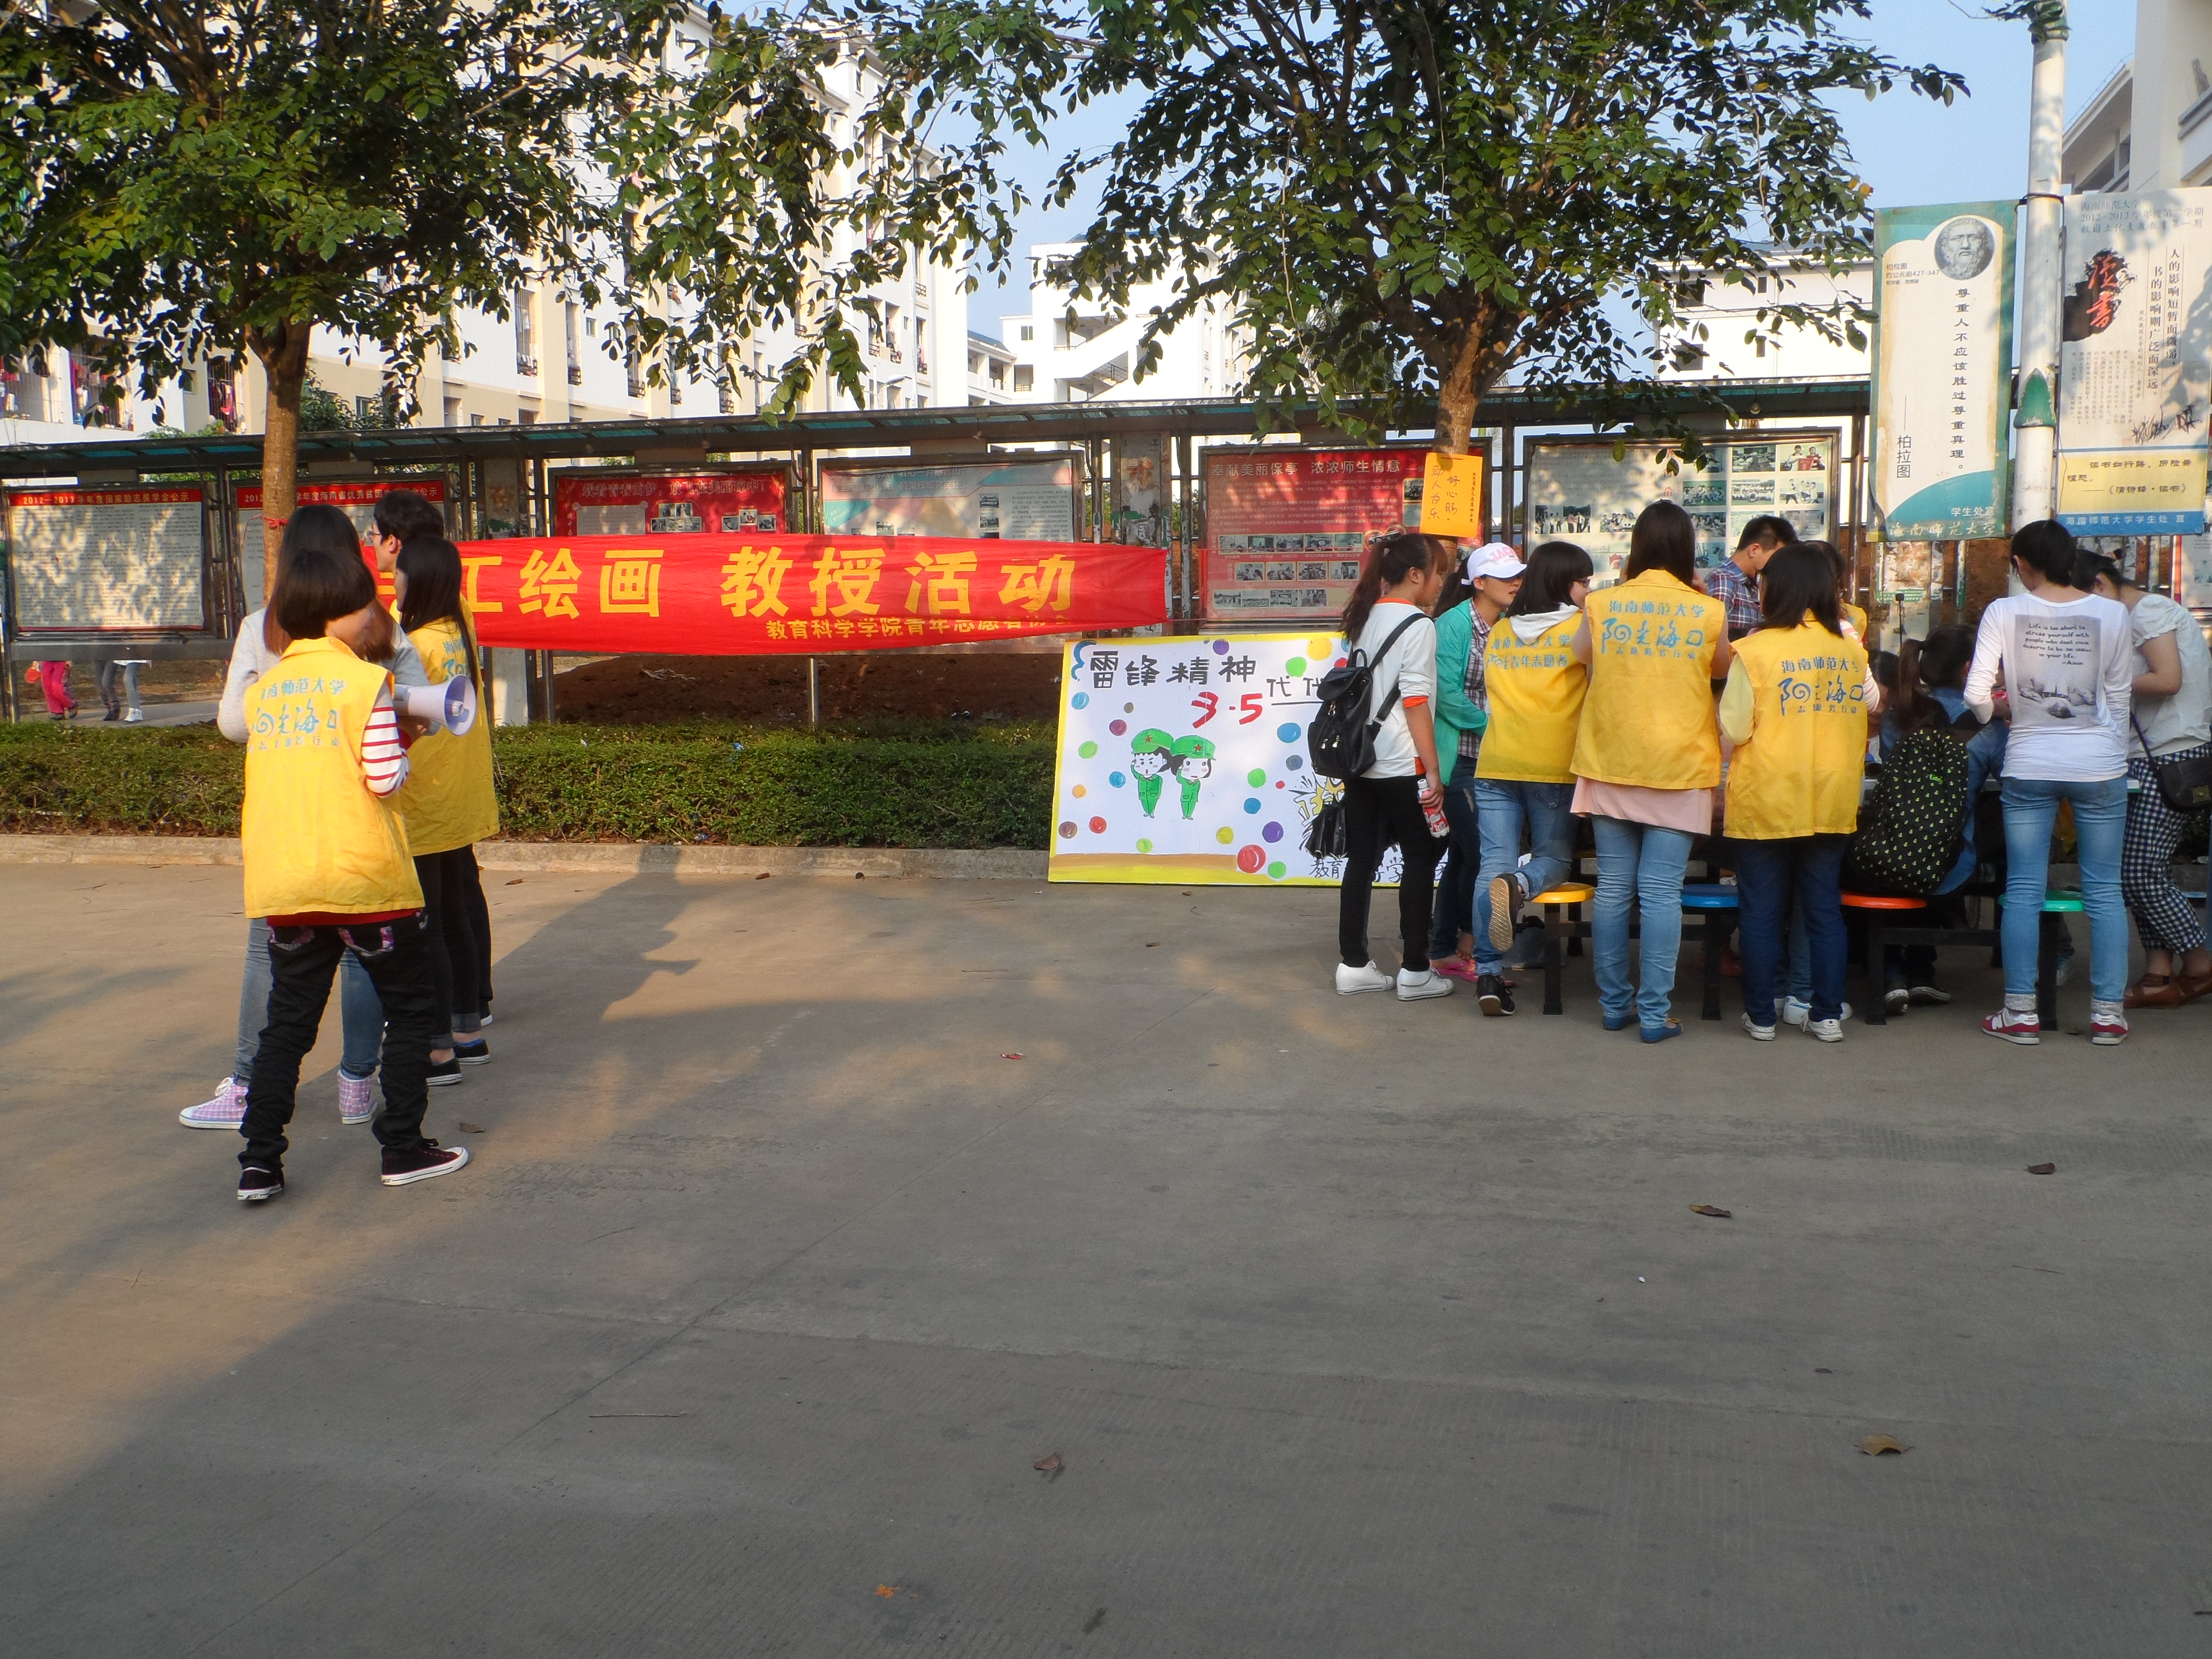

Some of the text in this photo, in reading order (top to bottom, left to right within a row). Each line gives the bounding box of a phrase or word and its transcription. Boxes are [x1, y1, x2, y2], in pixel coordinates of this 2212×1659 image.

[1950, 288, 1970, 470] 尊重人不应该胜过尊重真理。
[1211, 462, 1299, 477] 奉献美丽保亭
[1311, 459, 1400, 475] 浓浓师生情意
[721, 546, 1076, 617] 教授活动
[1609, 600, 1704, 618] 海南师范大学
[1601, 617, 1704, 654] 阳光海口
[1089, 650, 1257, 690] 雷锋精神
